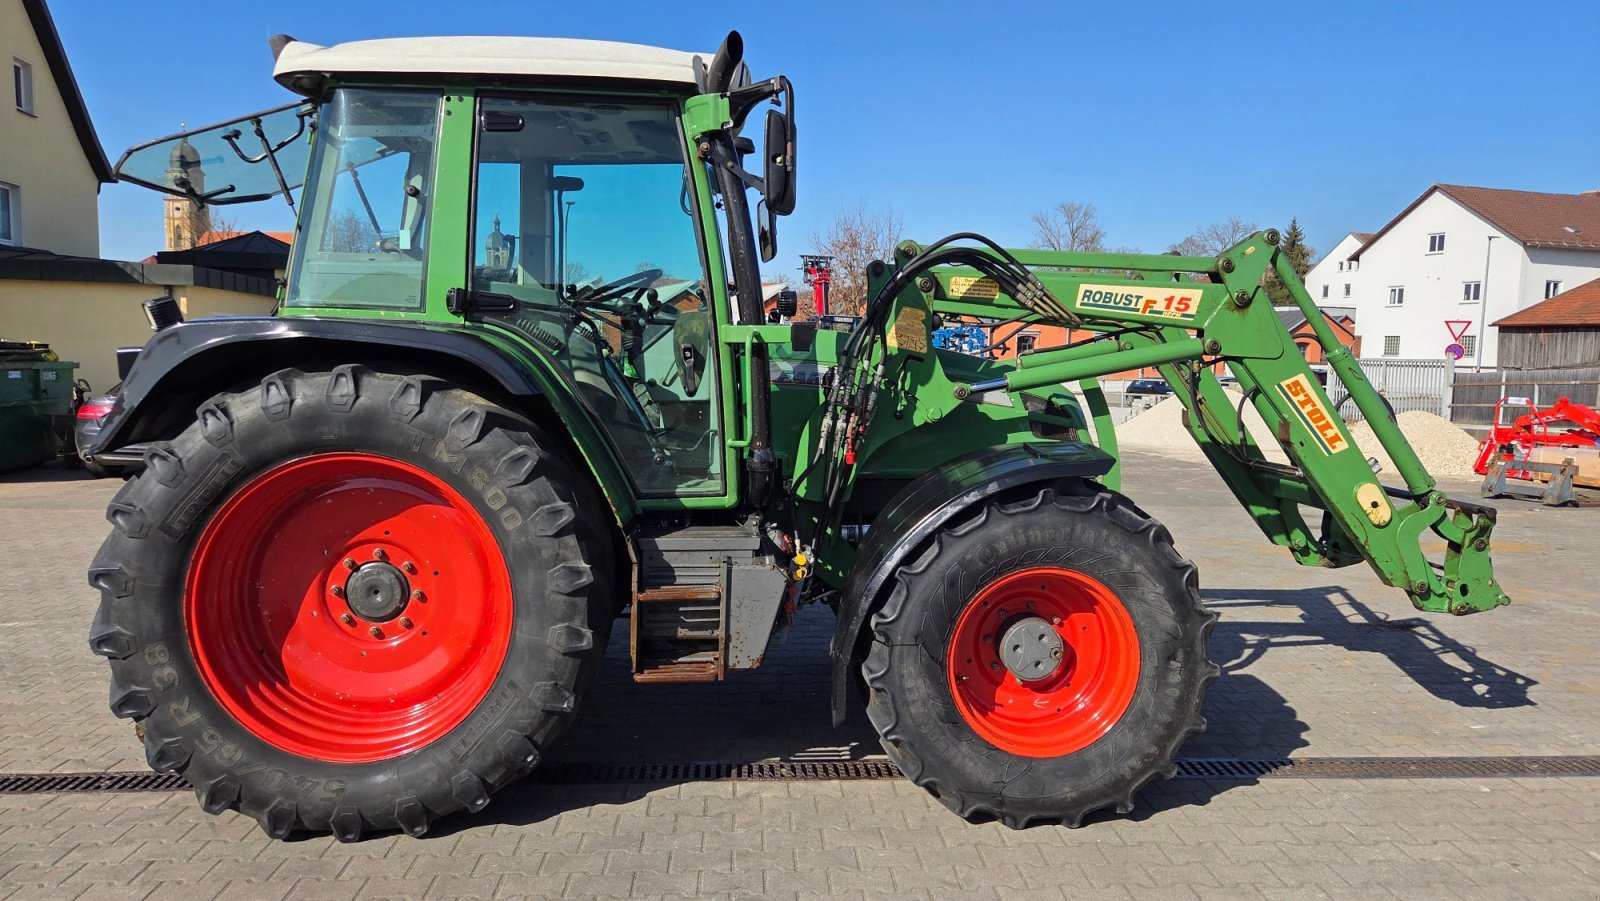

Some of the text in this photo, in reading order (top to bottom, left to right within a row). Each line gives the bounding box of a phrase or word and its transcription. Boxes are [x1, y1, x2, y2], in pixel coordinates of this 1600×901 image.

[1080, 289, 1193, 314] ROBUST F 15
[1285, 380, 1343, 449] STOLL
[143, 642, 180, 691] 38
[169, 696, 203, 728] R
